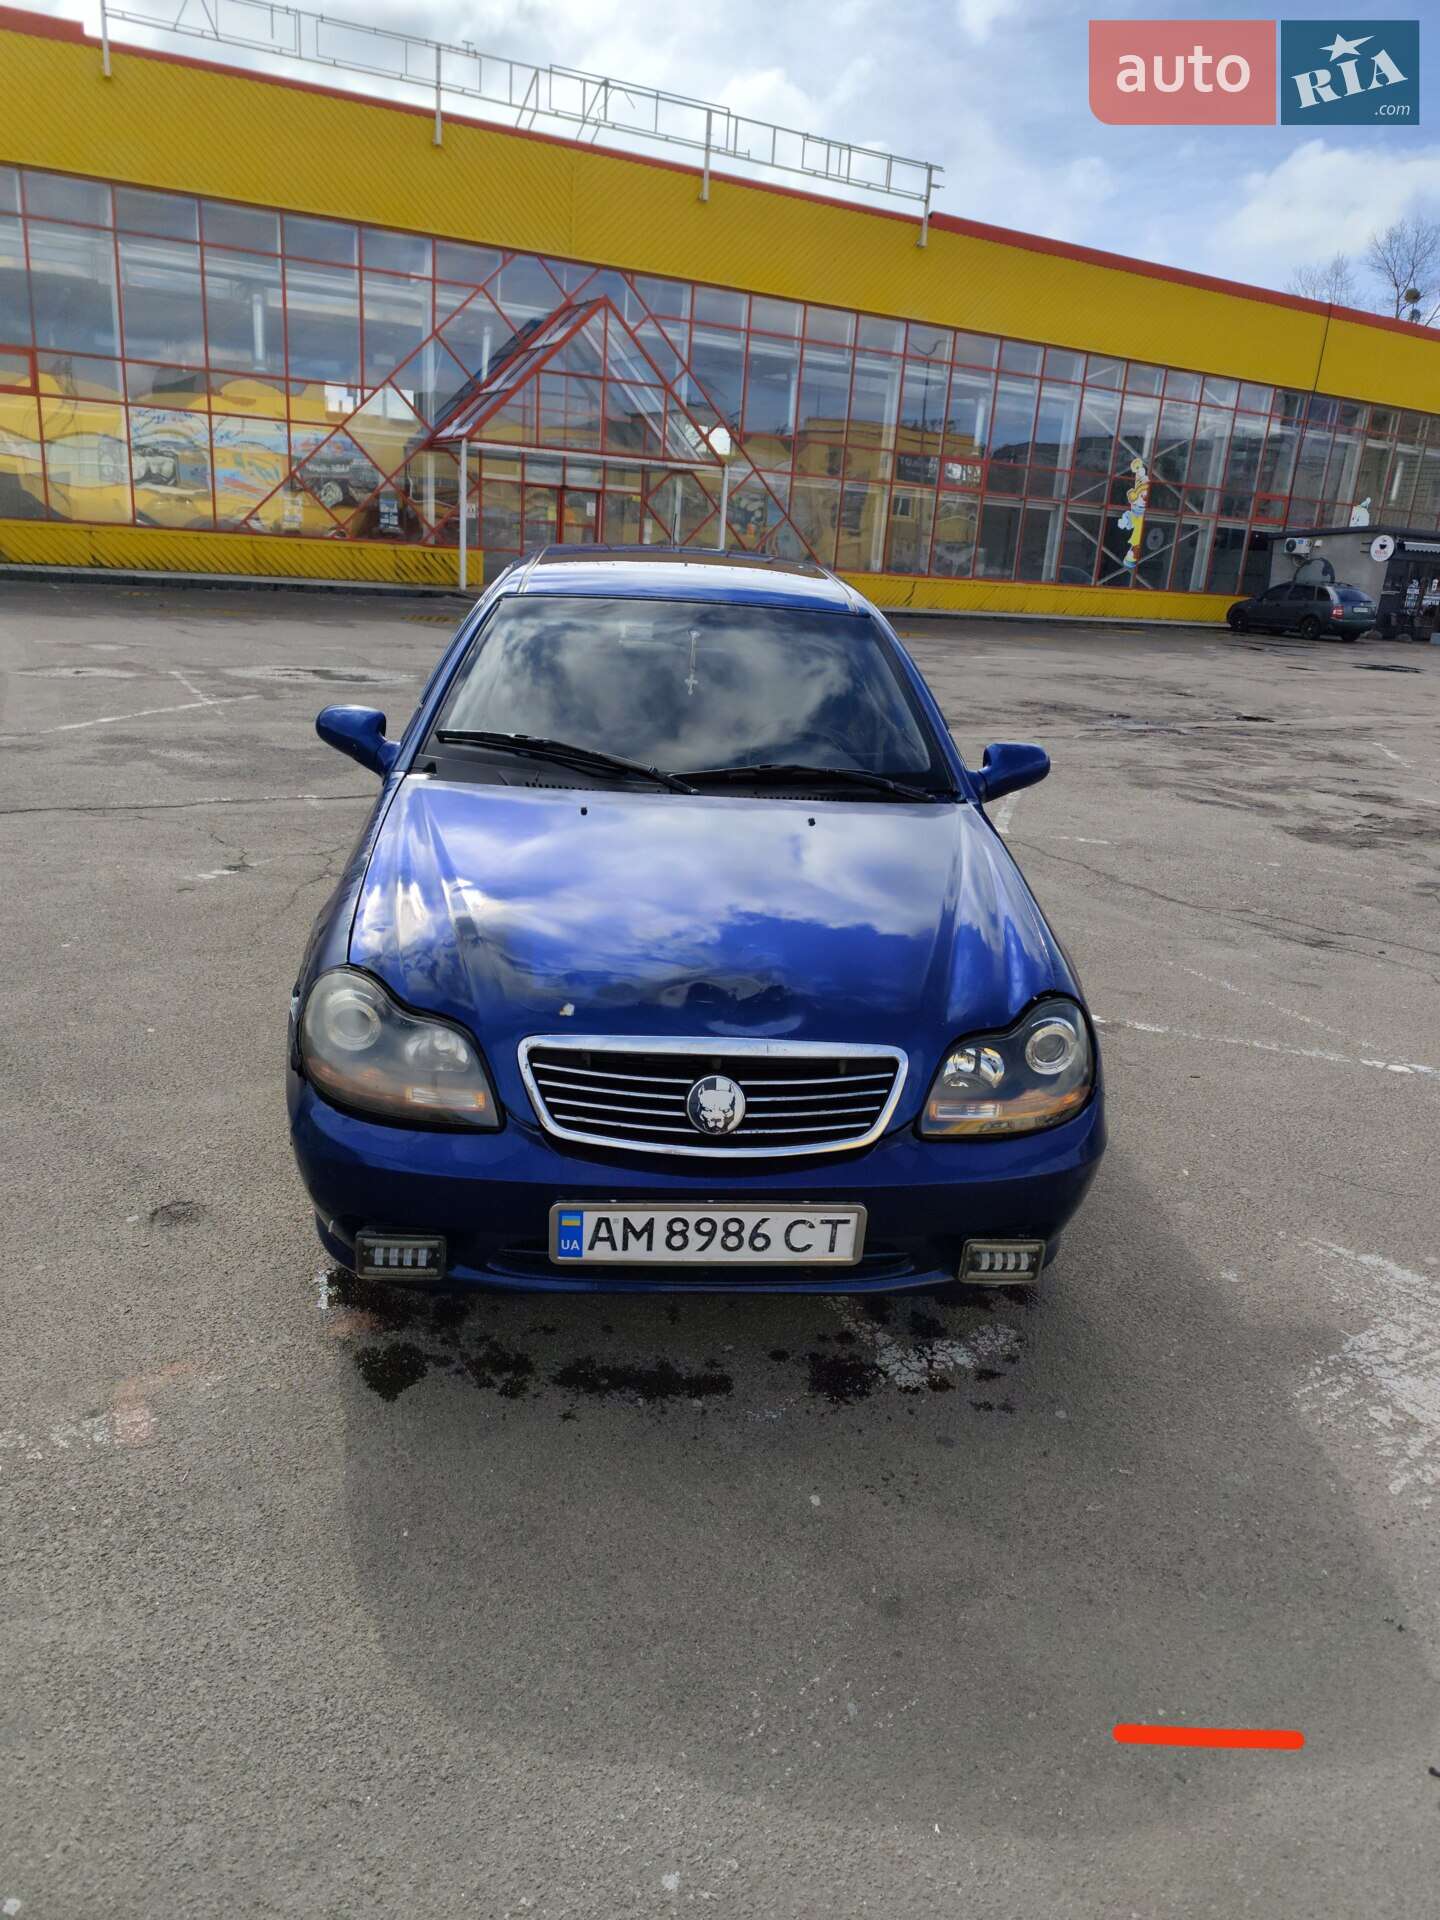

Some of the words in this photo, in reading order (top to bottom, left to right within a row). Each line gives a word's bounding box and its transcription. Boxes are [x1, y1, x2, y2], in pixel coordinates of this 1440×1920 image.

[560, 1239, 580, 1251] UA
[587, 1217, 653, 1252] AM
[664, 1217, 771, 1253] 8986
[784, 1219, 851, 1253] CT
